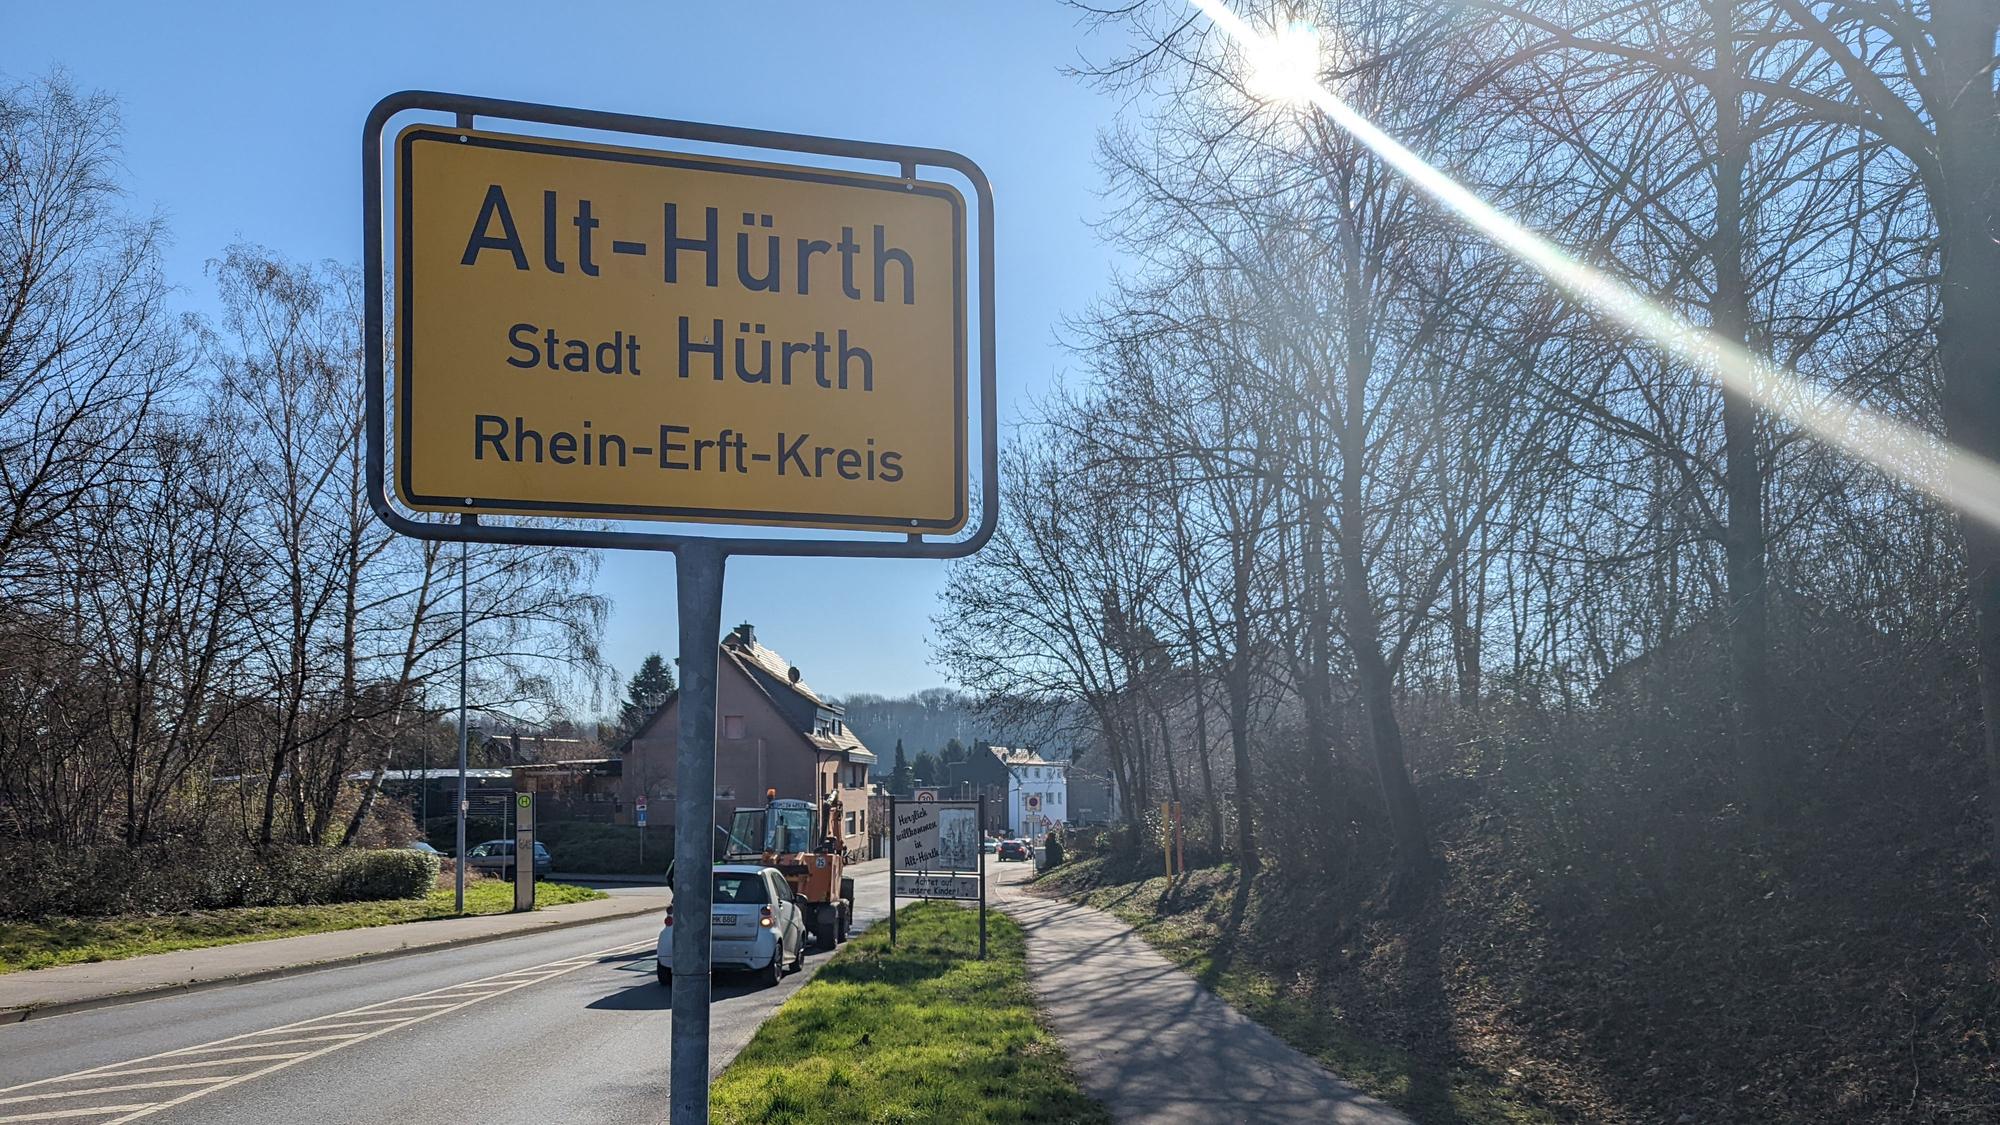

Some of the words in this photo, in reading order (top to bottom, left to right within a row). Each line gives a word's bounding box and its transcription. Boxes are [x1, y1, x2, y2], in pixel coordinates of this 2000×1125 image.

[459, 184, 915, 305] Alt-Hürth
[506, 323, 641, 376] Stadt
[678, 316, 874, 392] Hürth
[474, 414, 904, 483] Rhein-Erft-Kreis
[898, 808, 927, 826] Herzlich
[896, 821, 937, 842] willkommen
[914, 840, 922, 849] in
[817, 858, 825, 867] 25
[908, 887, 931, 895] unsere
[914, 877, 938, 887] Achtet
[940, 878, 953, 887] auf
